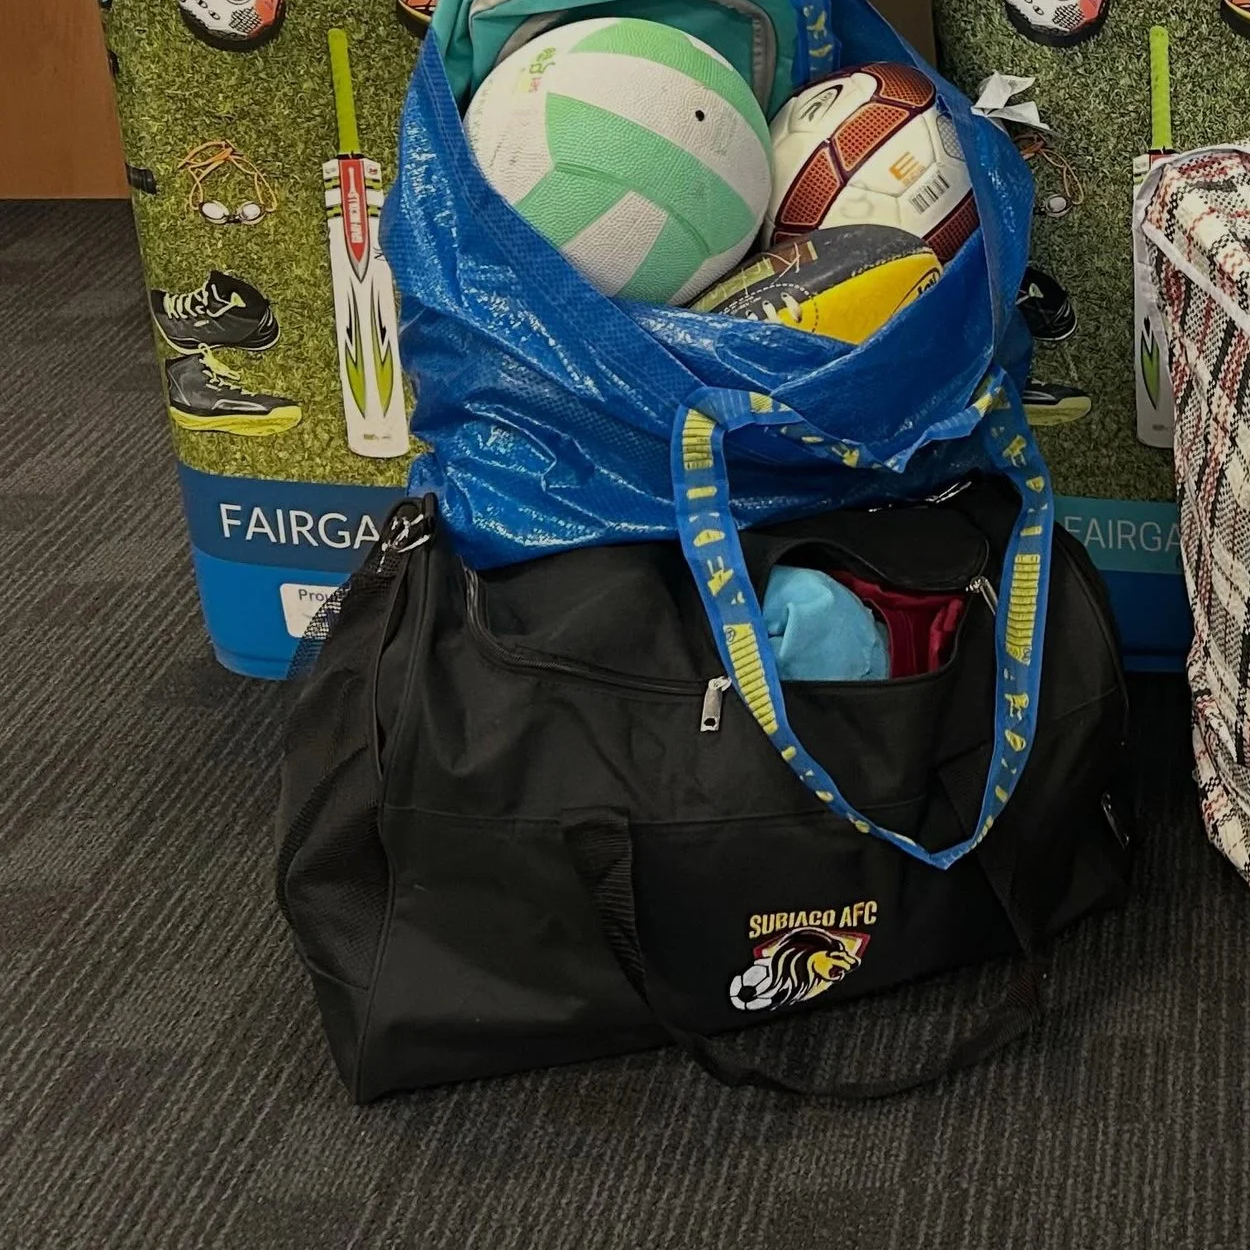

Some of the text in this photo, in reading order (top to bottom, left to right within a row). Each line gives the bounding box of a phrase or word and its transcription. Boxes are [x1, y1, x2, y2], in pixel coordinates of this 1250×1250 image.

[219, 503, 380, 549] FAIRGA
[1064, 516, 1181, 553] FAIRGA
[298, 588, 333, 601] Prou
[748, 900, 878, 940] SUBIACO AFC
